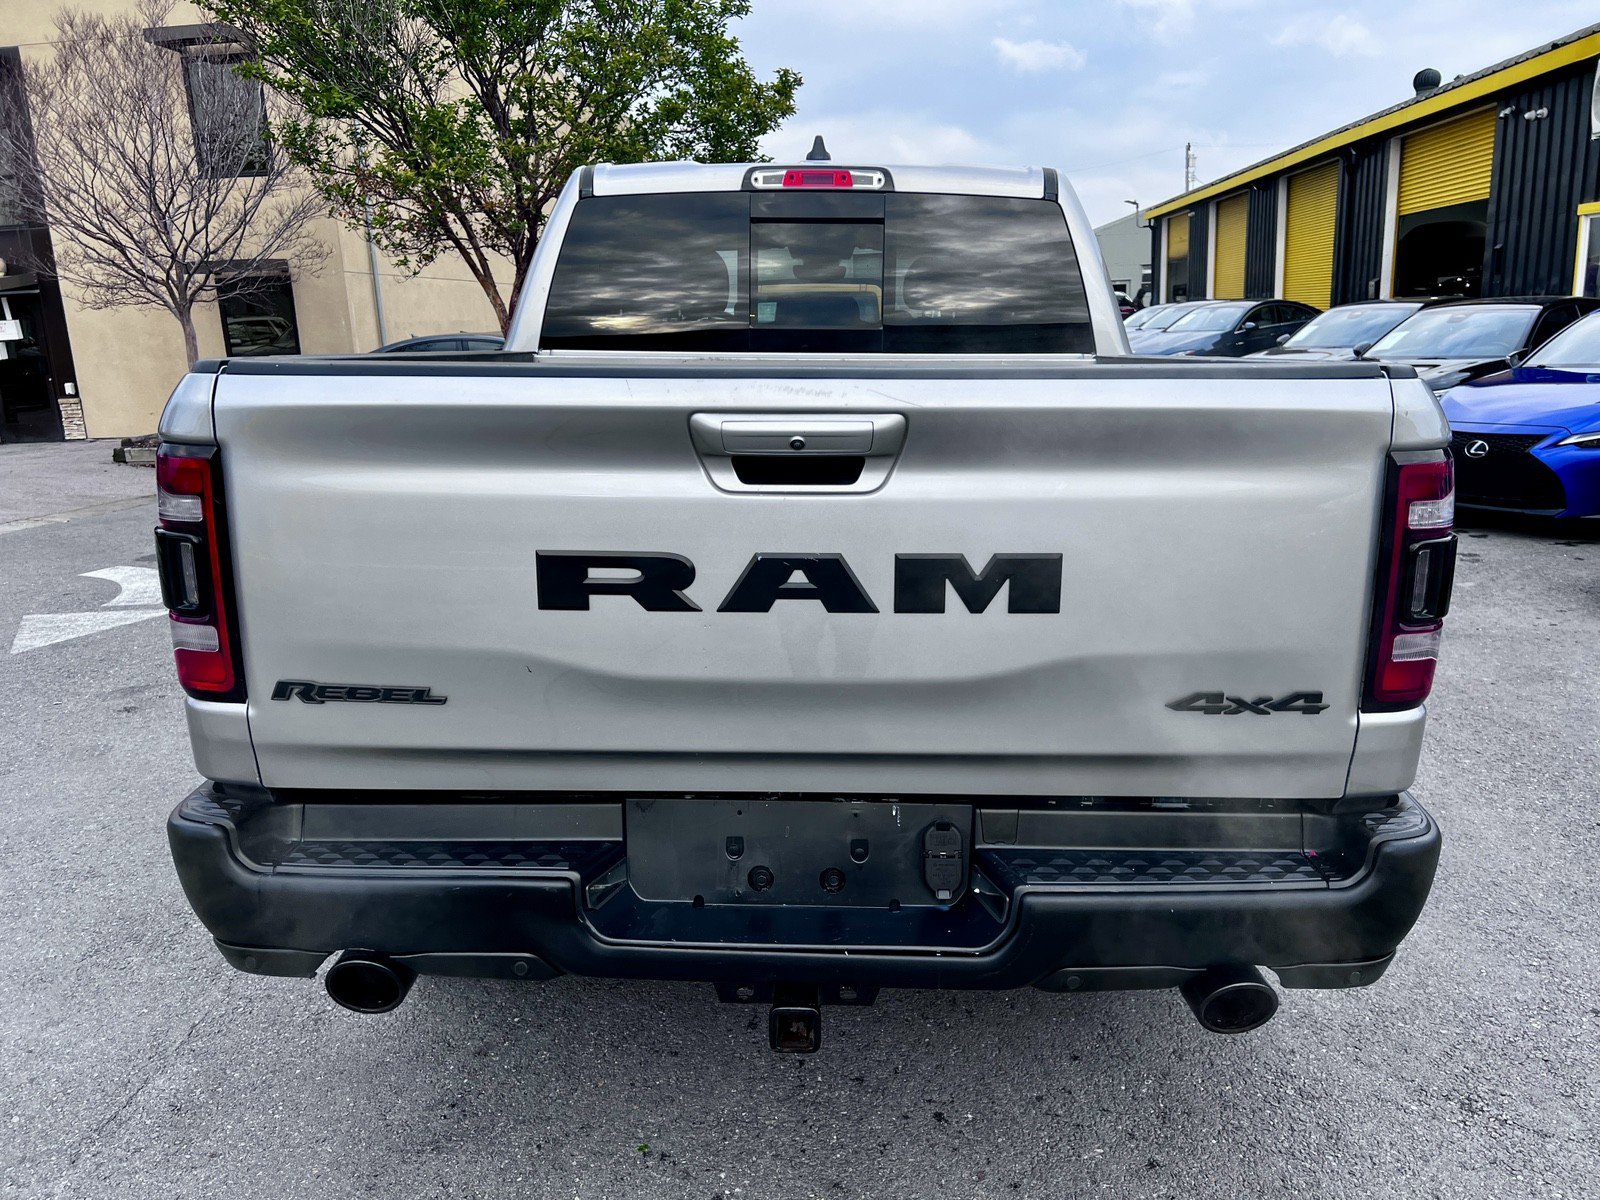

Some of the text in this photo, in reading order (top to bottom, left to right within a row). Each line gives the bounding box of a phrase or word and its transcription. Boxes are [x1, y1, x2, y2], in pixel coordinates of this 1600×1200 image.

[535, 549, 1063, 614] RAM
[271, 679, 448, 705] REBEL
[1165, 690, 1331, 715] 4x4
